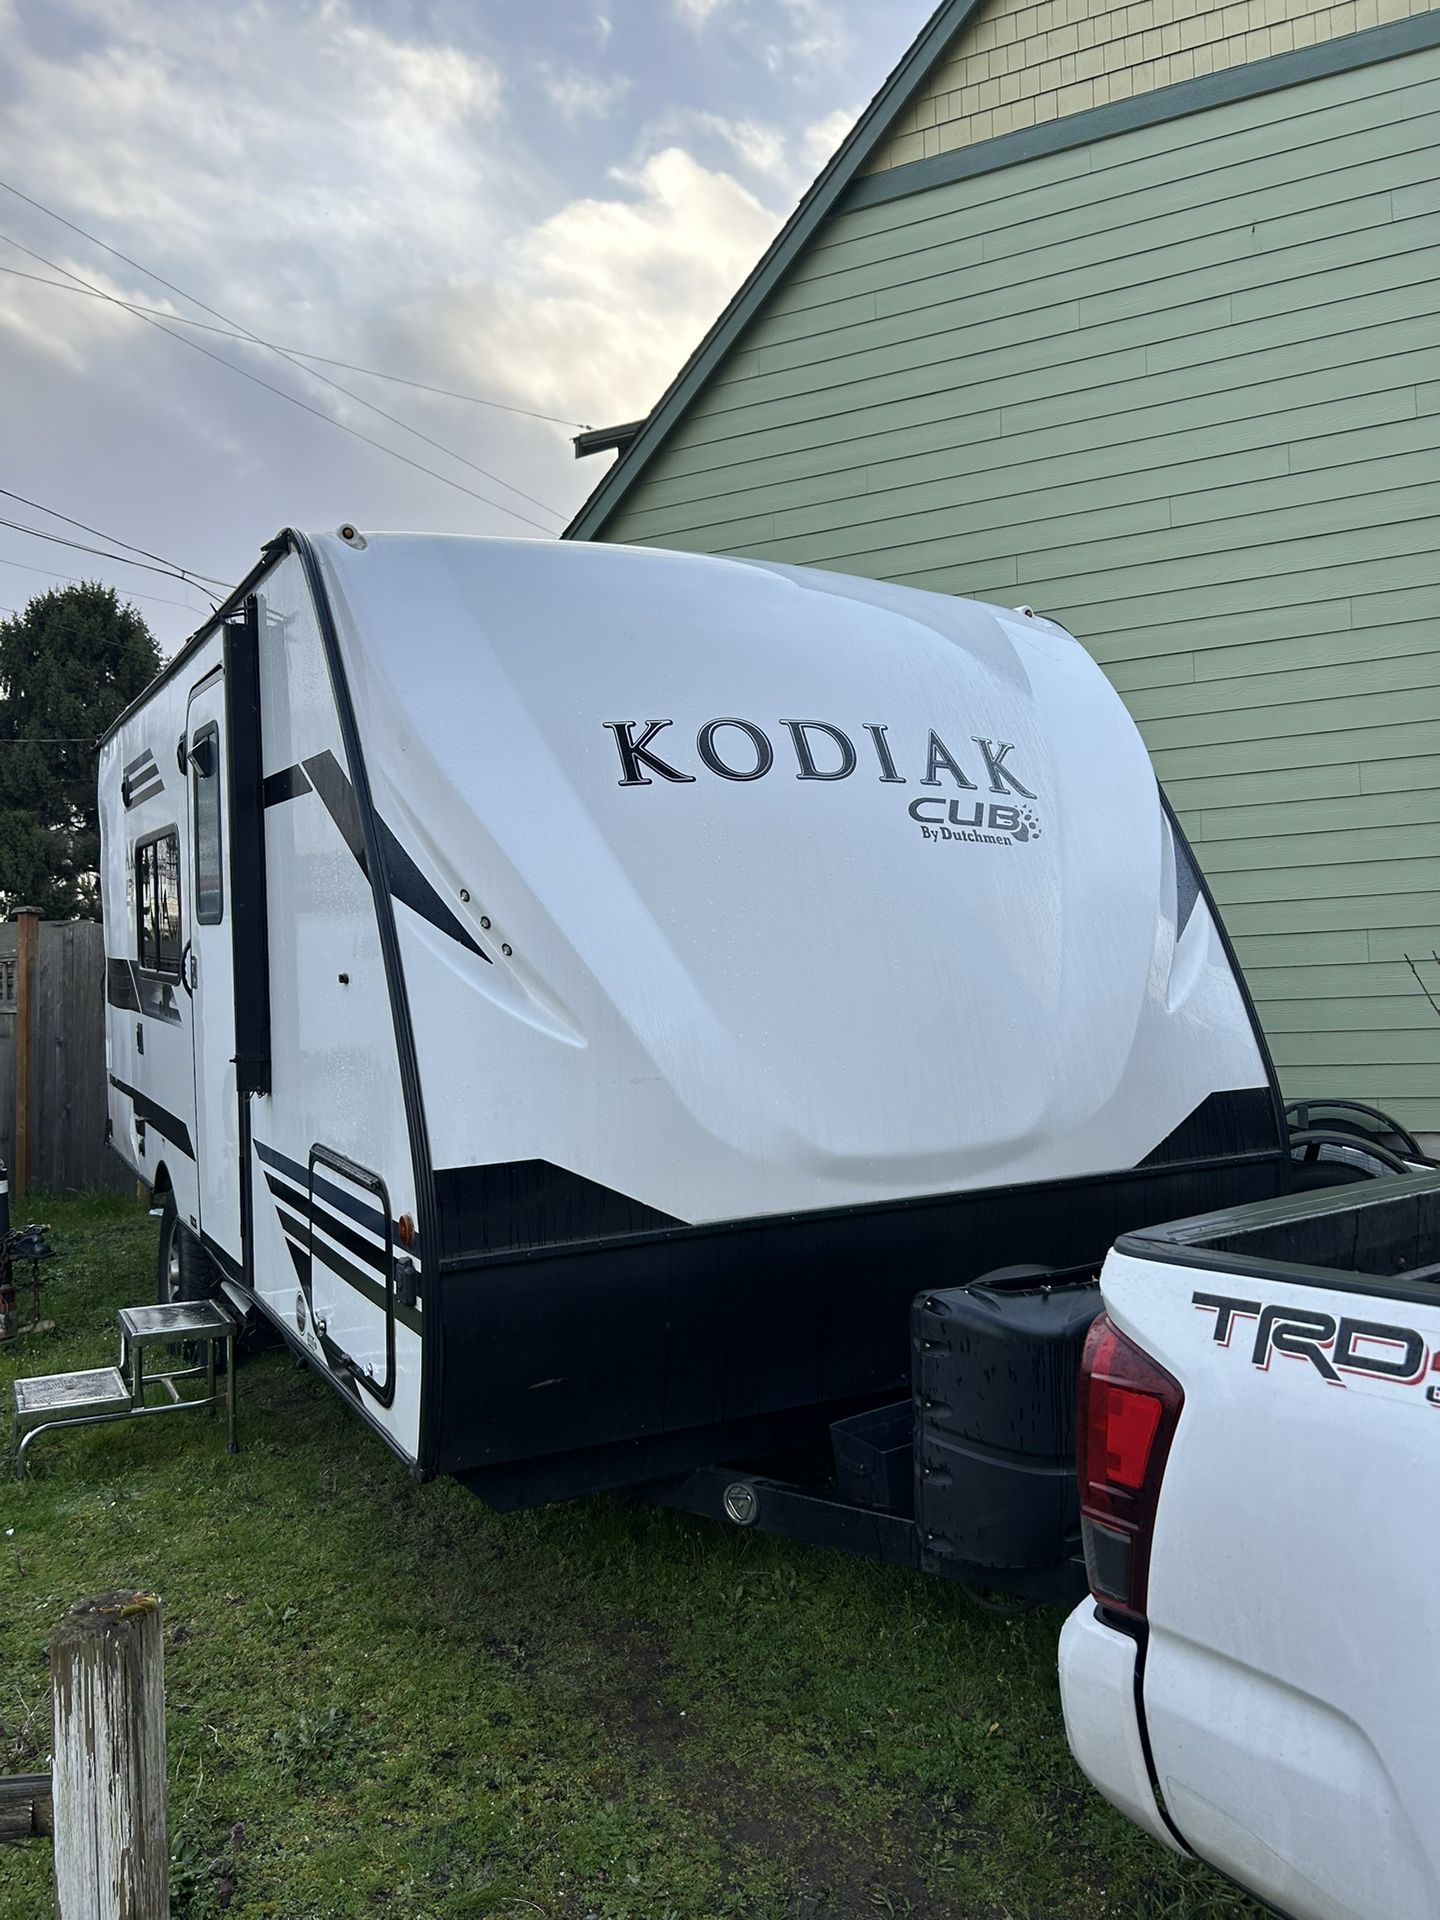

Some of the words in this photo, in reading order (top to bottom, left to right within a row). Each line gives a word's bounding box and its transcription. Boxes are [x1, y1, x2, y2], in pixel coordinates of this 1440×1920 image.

[602, 716, 1038, 800] KODIAK
[908, 797, 1021, 831] CUB
[920, 825, 938, 843] By
[940, 826, 1013, 846] Dutchmen
[1191, 1291, 1429, 1388] TRD
